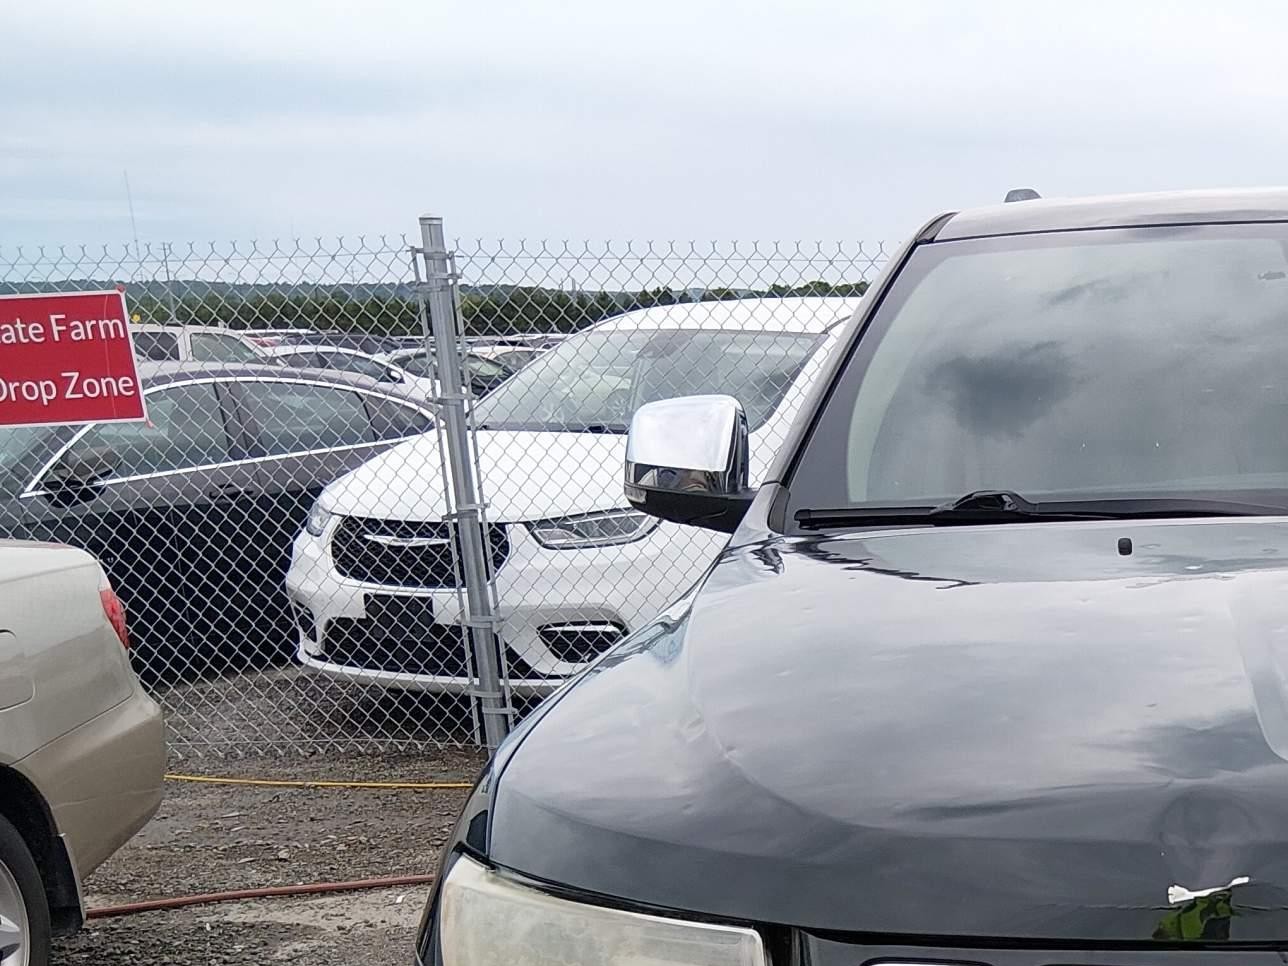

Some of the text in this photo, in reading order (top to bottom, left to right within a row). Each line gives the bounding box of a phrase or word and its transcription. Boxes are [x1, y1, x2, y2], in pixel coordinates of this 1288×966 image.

[0, 314, 126, 344] ate Farm
[61, 371, 136, 400] Zone
